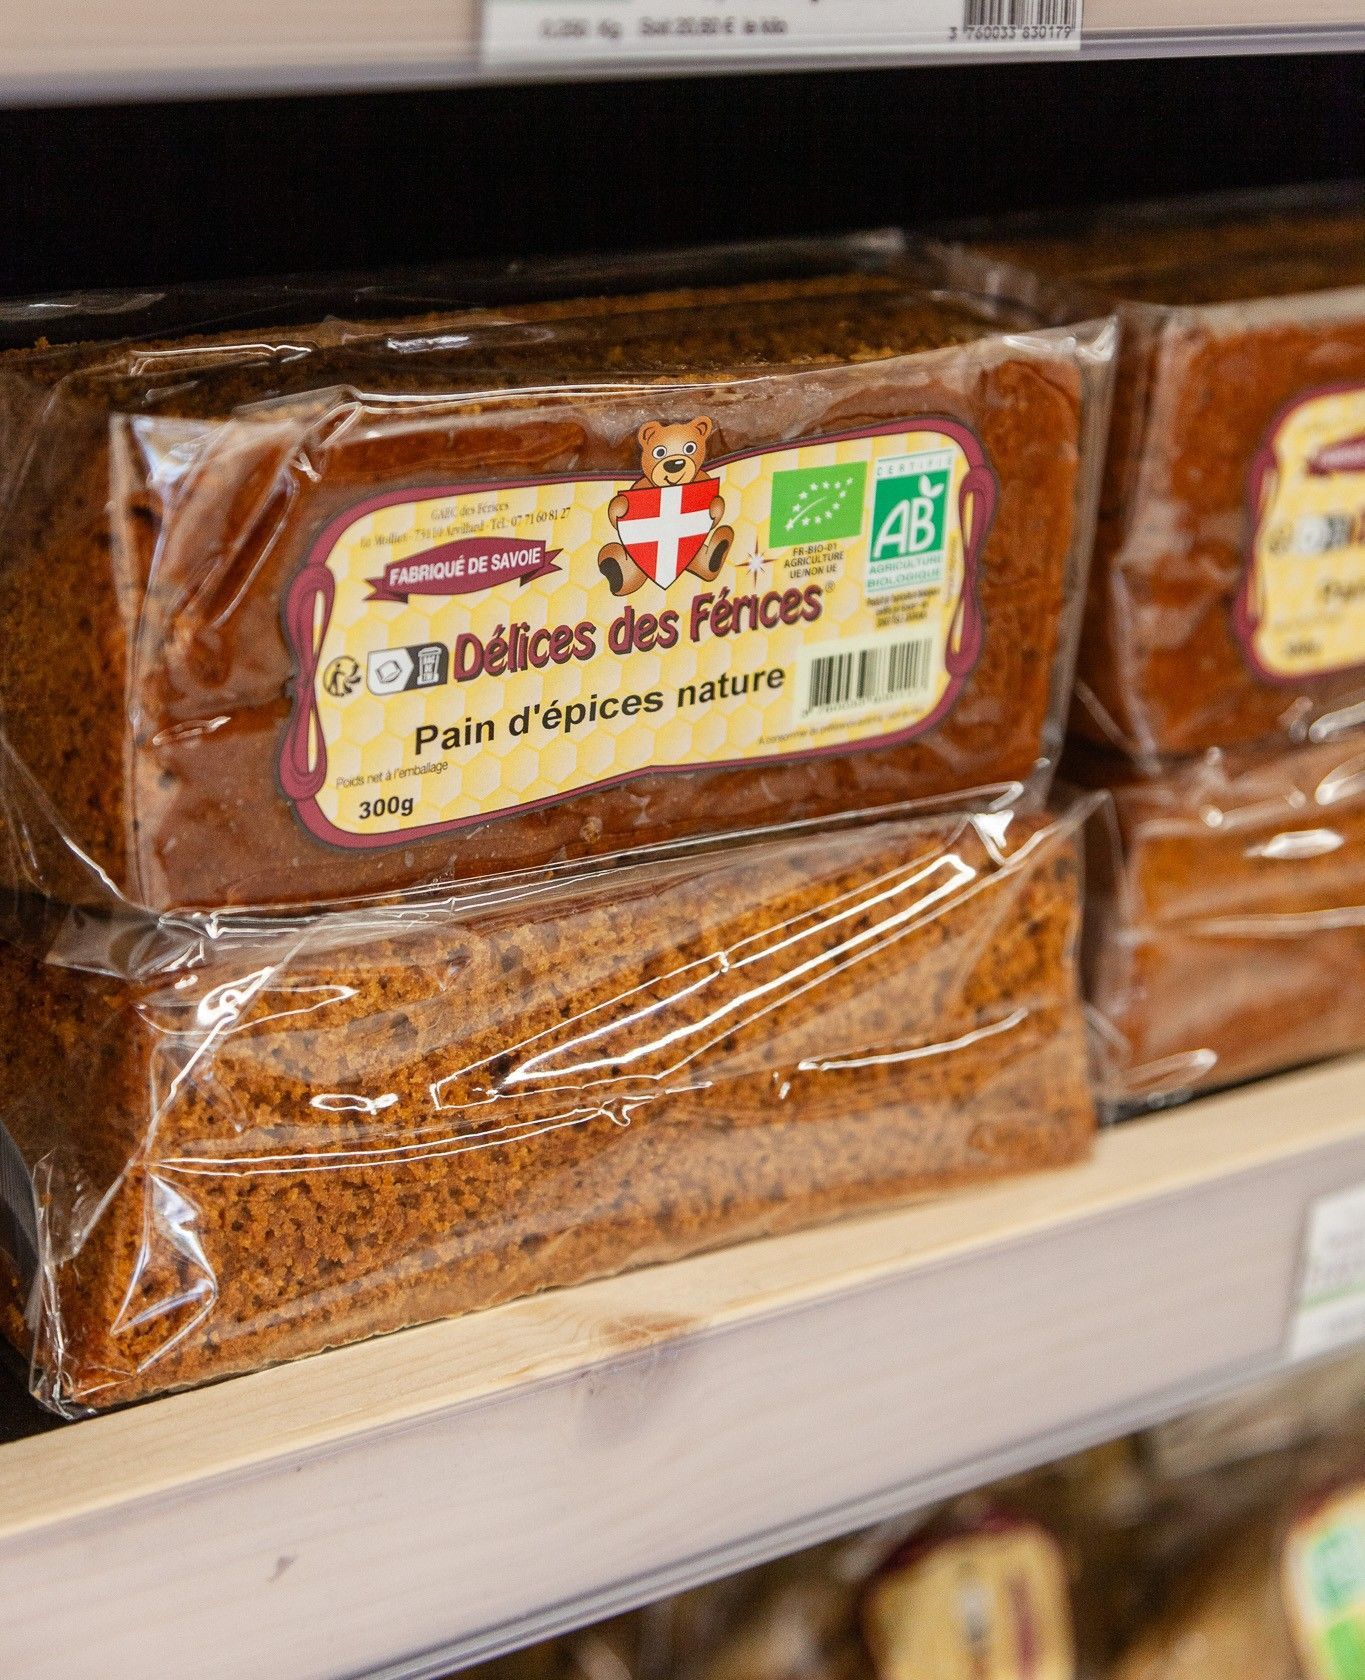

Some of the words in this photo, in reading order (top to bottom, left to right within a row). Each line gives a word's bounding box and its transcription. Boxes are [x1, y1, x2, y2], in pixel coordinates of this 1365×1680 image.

[948, 26, 958, 40] 3
[1021, 25, 1072, 39] 830179
[536, 510, 547, 523] 60
[548, 508, 558, 521] 81
[560, 506, 571, 519] 27
[873, 497, 936, 559] AB
[784, 551, 844, 568] AGRICULTURE
[792, 543, 838, 557] FR-BIO-01
[389, 554, 465, 587] FABRIQUÉ
[468, 555, 488, 575] DE
[491, 547, 542, 571] SAVOIE
[790, 566, 824, 579] UE/NON
[826, 563, 838, 573] UE
[453, 622, 597, 682] Délices
[608, 605, 679, 653] des
[689, 583, 824, 643] Férices
[414, 718, 496, 755] Pain
[508, 690, 664, 735] d'épices
[677, 666, 786, 709] nature
[336, 774, 365, 789] Poids
[366, 772, 383, 784] net
[385, 770, 393, 781] à
[393, 761, 449, 780] l'emballage
[358, 796, 414, 820] 300g
